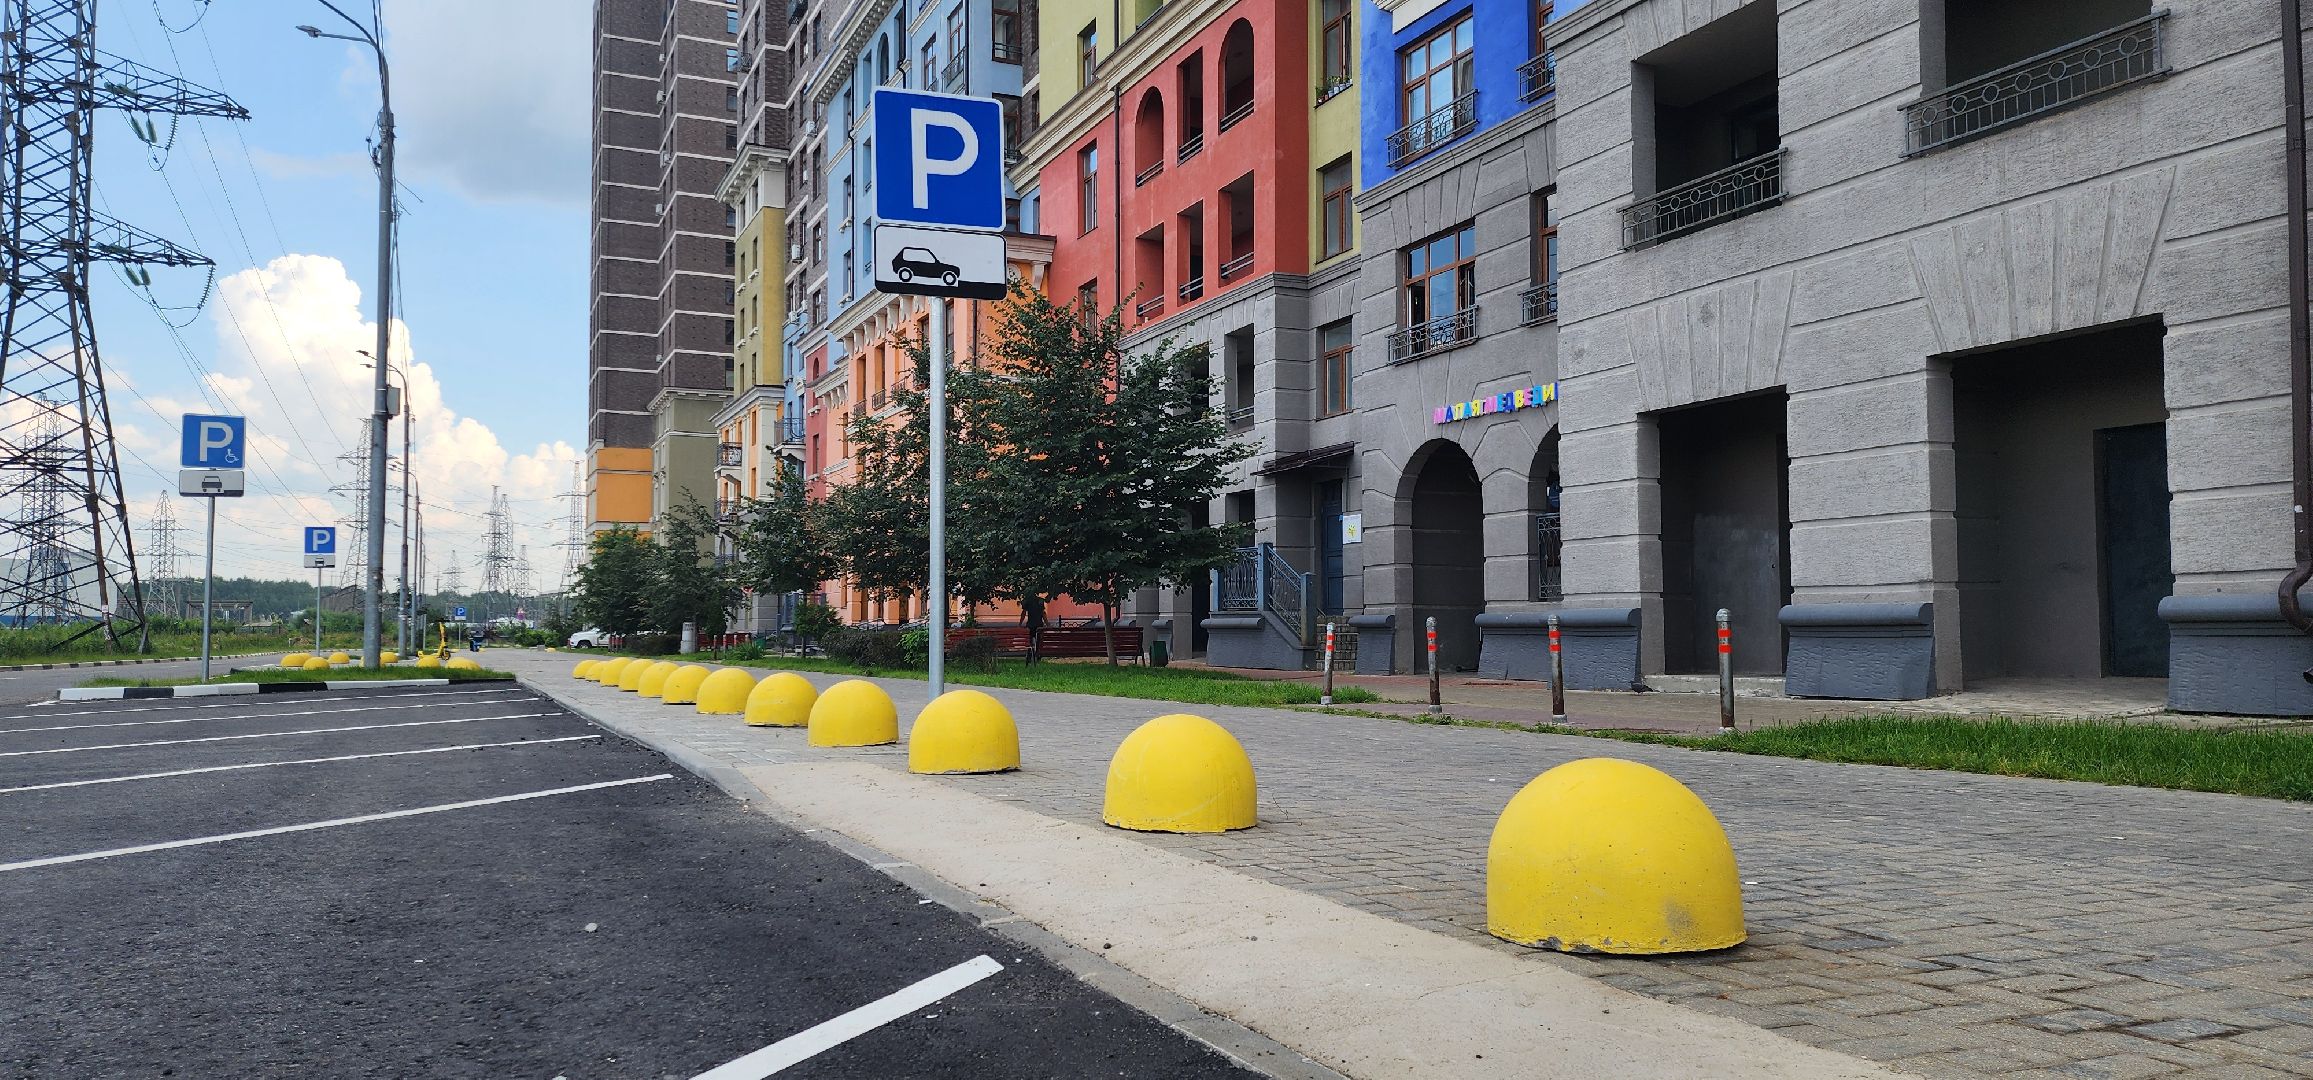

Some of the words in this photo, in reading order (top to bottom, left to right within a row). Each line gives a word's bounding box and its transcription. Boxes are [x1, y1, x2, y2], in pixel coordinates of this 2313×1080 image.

[911, 107, 979, 210] P
[200, 421, 234, 462] P
[312, 529, 330, 551] P
